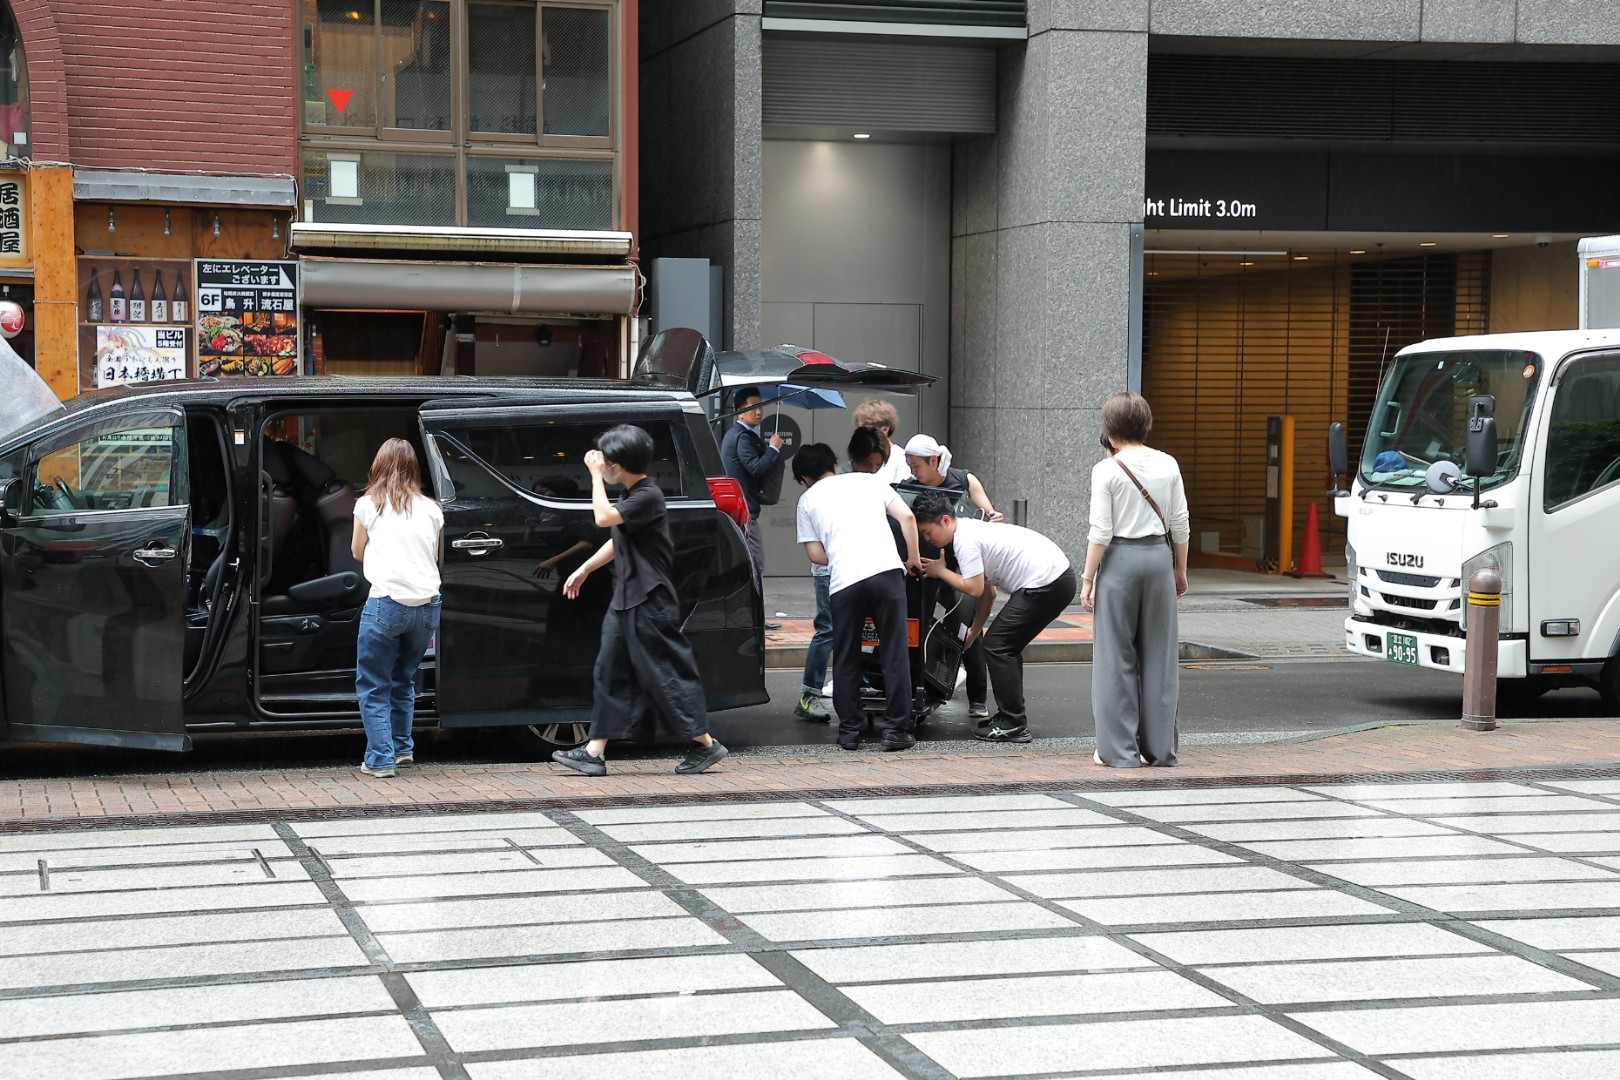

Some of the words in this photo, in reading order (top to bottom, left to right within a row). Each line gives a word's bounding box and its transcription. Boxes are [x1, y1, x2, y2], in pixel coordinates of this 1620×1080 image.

[1143, 198, 1165, 217] ht
[1170, 198, 1211, 217] Limit
[1216, 199, 1256, 217] 3.0m
[0, 182, 20, 253] 居酒屋
[203, 264, 278, 274] 左にエレベーター
[232, 275, 278, 285] ございます
[201, 294, 220, 306] 6F
[261, 299, 294, 310] 流石屋
[157, 330, 182, 340] 当ビル
[104, 366, 182, 382] 日本橋横丁
[1358, 508, 1375, 516] ELF
[1387, 552, 1424, 568] ISUZU
